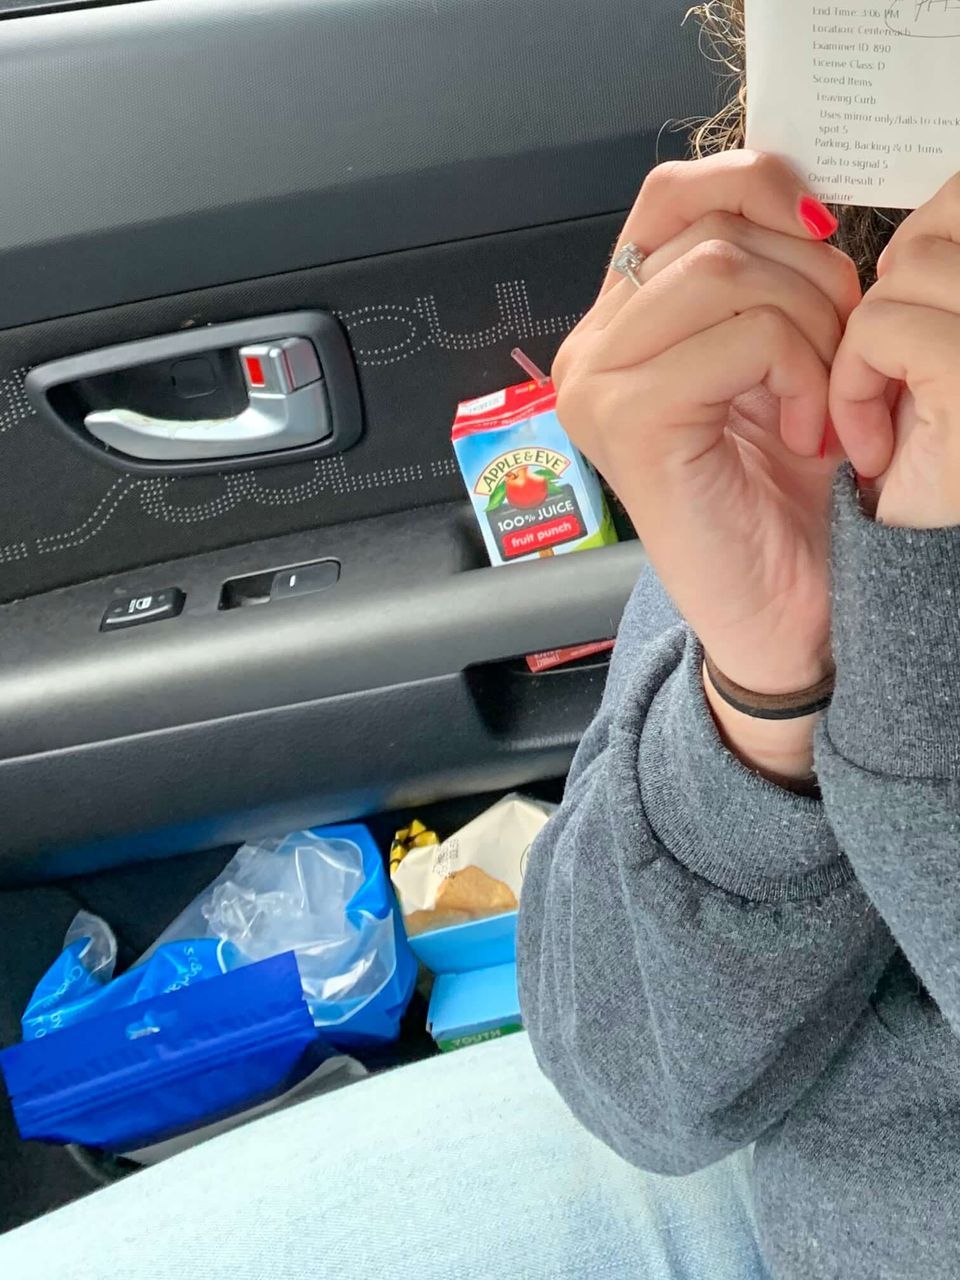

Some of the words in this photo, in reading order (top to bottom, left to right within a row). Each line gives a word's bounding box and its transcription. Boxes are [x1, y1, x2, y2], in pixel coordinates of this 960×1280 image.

[812, 6, 831, 16] End
[884, 9, 900, 19] PM
[873, 43, 892, 54] 890
[812, 58, 847, 68] License
[877, 61, 886, 71] D
[812, 74, 846, 85] Scored
[847, 76, 873, 87] Items
[854, 95, 877, 105] Curb
[820, 109, 841, 119] Uses
[844, 111, 872, 122] mirror
[920, 116, 931, 125] to
[933, 116, 960, 127] check
[818, 125, 839, 135] spot
[854, 140, 891, 154] Backing
[816, 155, 837, 165] Fails
[839, 157, 850, 166] to
[852, 158, 880, 170] signal
[808, 172, 843, 184] Overall
[482, 453, 522, 493] APPLE
[523, 450, 533, 462] &
[534, 449, 563, 471] EVE
[497, 511, 536, 532] 100%
[537, 499, 575, 520] JUICE
[511, 532, 535, 549] fruit
[537, 522, 572, 541] punch
